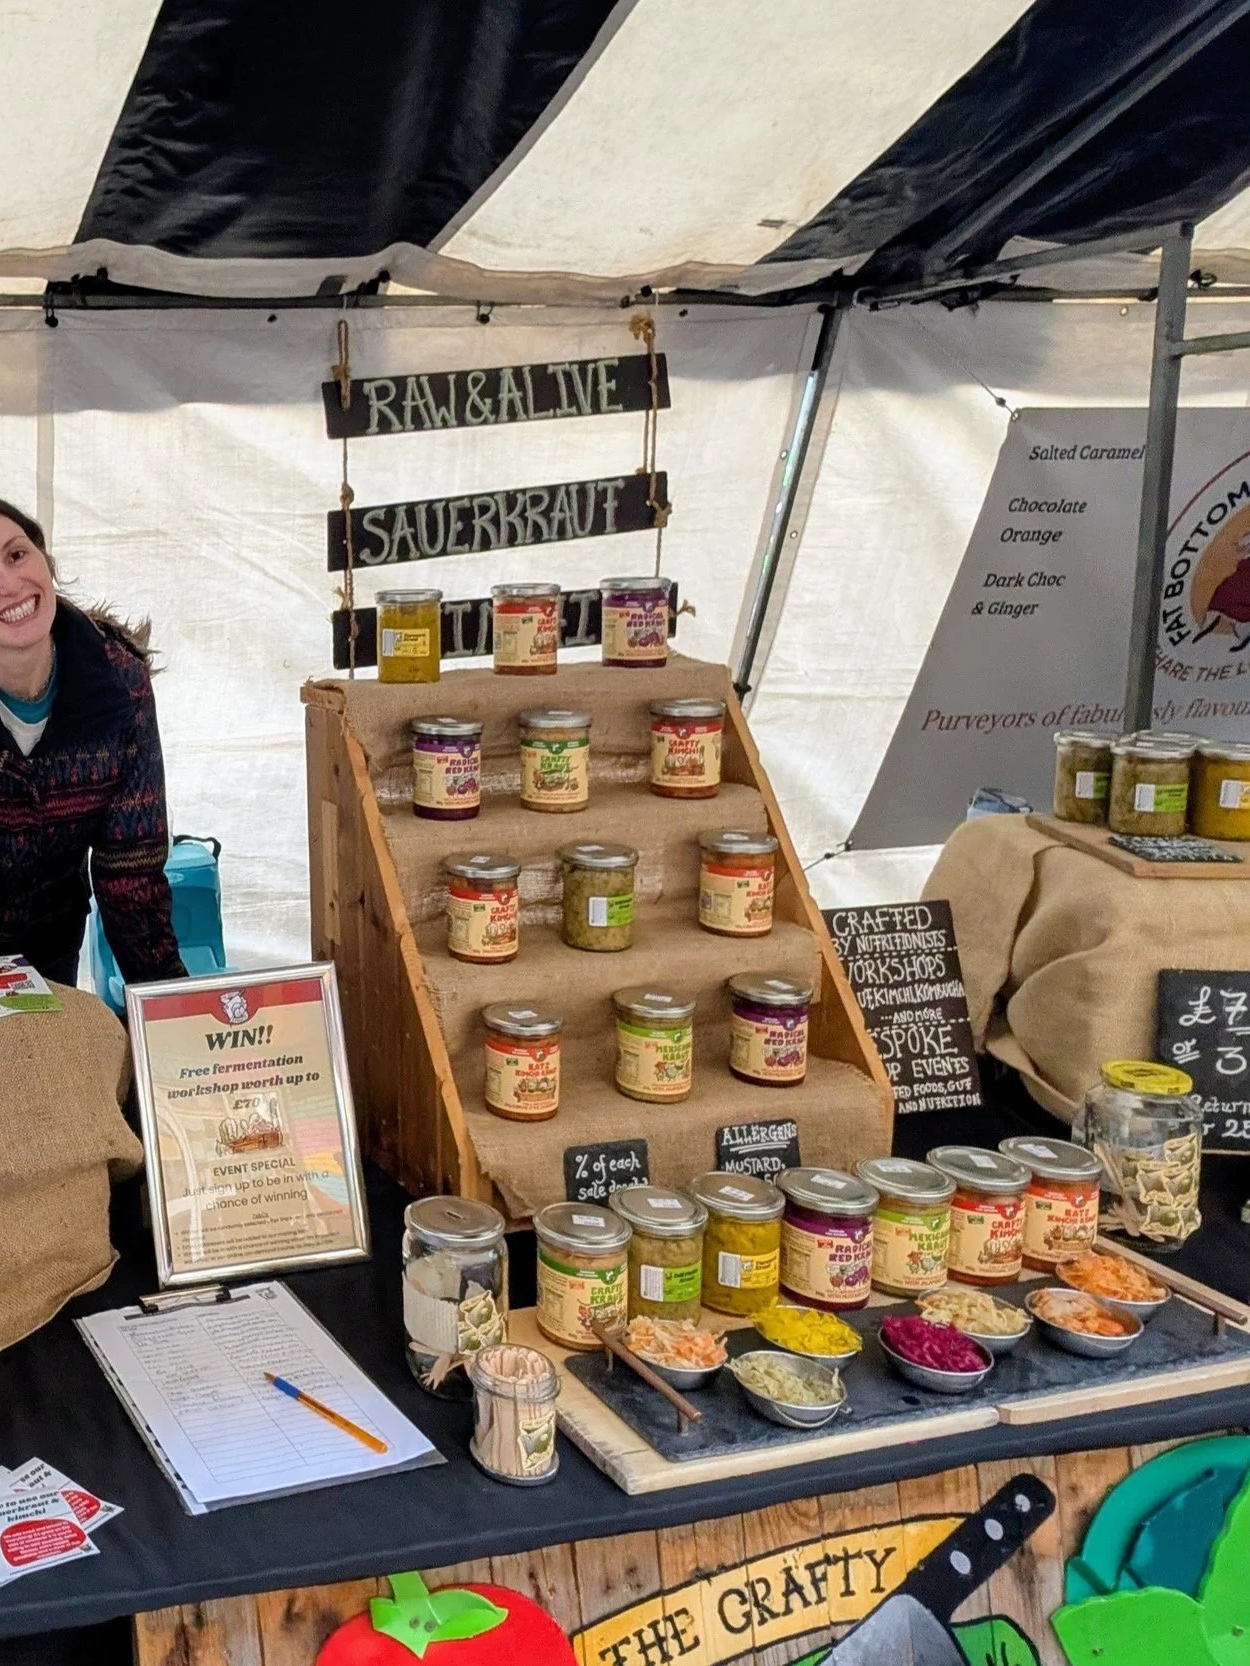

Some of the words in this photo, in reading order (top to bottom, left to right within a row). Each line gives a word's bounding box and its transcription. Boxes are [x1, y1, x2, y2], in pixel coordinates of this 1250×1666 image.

[1029, 445, 1077, 461] Salted
[1079, 443, 1146, 461] Caramel
[1008, 498, 1088, 514] Chocolate
[359, 479, 625, 566] SAUERKRAUT
[1000, 528, 1063, 545] Orange
[983, 573, 1024, 588] Dark
[1027, 572, 1067, 588] Choc
[971, 602, 984, 616] &
[987, 602, 1039, 619] Ginger
[1162, 606, 1193, 647] FAT
[1155, 651, 1193, 682] HARE
[1196, 665, 1232, 682] THE
[920, 708, 1037, 735] Purveyors
[1041, 705, 1069, 729] of
[832, 906, 932, 937] CRAFTED
[857, 930, 947, 953] NUTRITIONISTS
[914, 980, 965, 1003] KOMBUCHA
[915, 1007, 943, 1021] MORE
[205, 1025, 273, 1051] WIN!!
[869, 1025, 959, 1059] SPOKE
[1172, 1038, 1198, 1054] or
[180, 1067, 210, 1079] Free
[212, 1055, 304, 1075] fermentation
[912, 1056, 970, 1078] EVENTS
[1216, 1046, 1248, 1075] 3
[167, 1082, 239, 1099] workshop
[241, 1075, 283, 1091] worth
[286, 1073, 304, 1085] up
[306, 1071, 320, 1082] to
[947, 1078, 972, 1092] GUT
[898, 1102, 918, 1114] AND
[919, 1093, 982, 1112] NUTRITION
[721, 1122, 797, 1146] ALLERGENS
[213, 1163, 249, 1177] EVENT
[251, 1157, 296, 1172] SPECIAL
[575, 1154, 589, 1179] %
[592, 1154, 607, 1184] of
[609, 1150, 642, 1172] each
[183, 1186, 207, 1198] Just
[209, 1182, 232, 1196] sign
[235, 1181, 250, 1193] up
[252, 1179, 264, 1189] to
[266, 1175, 281, 1186] be
[283, 1173, 294, 1184] in
[296, 1170, 319, 1183] with
[321, 1170, 329, 1179] a
[578, 1181, 608, 1201] sale
[206, 1196, 248, 1211] chance
[250, 1193, 262, 1205] of
[264, 1188, 308, 1203] winning
[18, 1495, 38, 1505] use
[39, 1490, 60, 1500] our
[598, 1605, 701, 1666] THE
